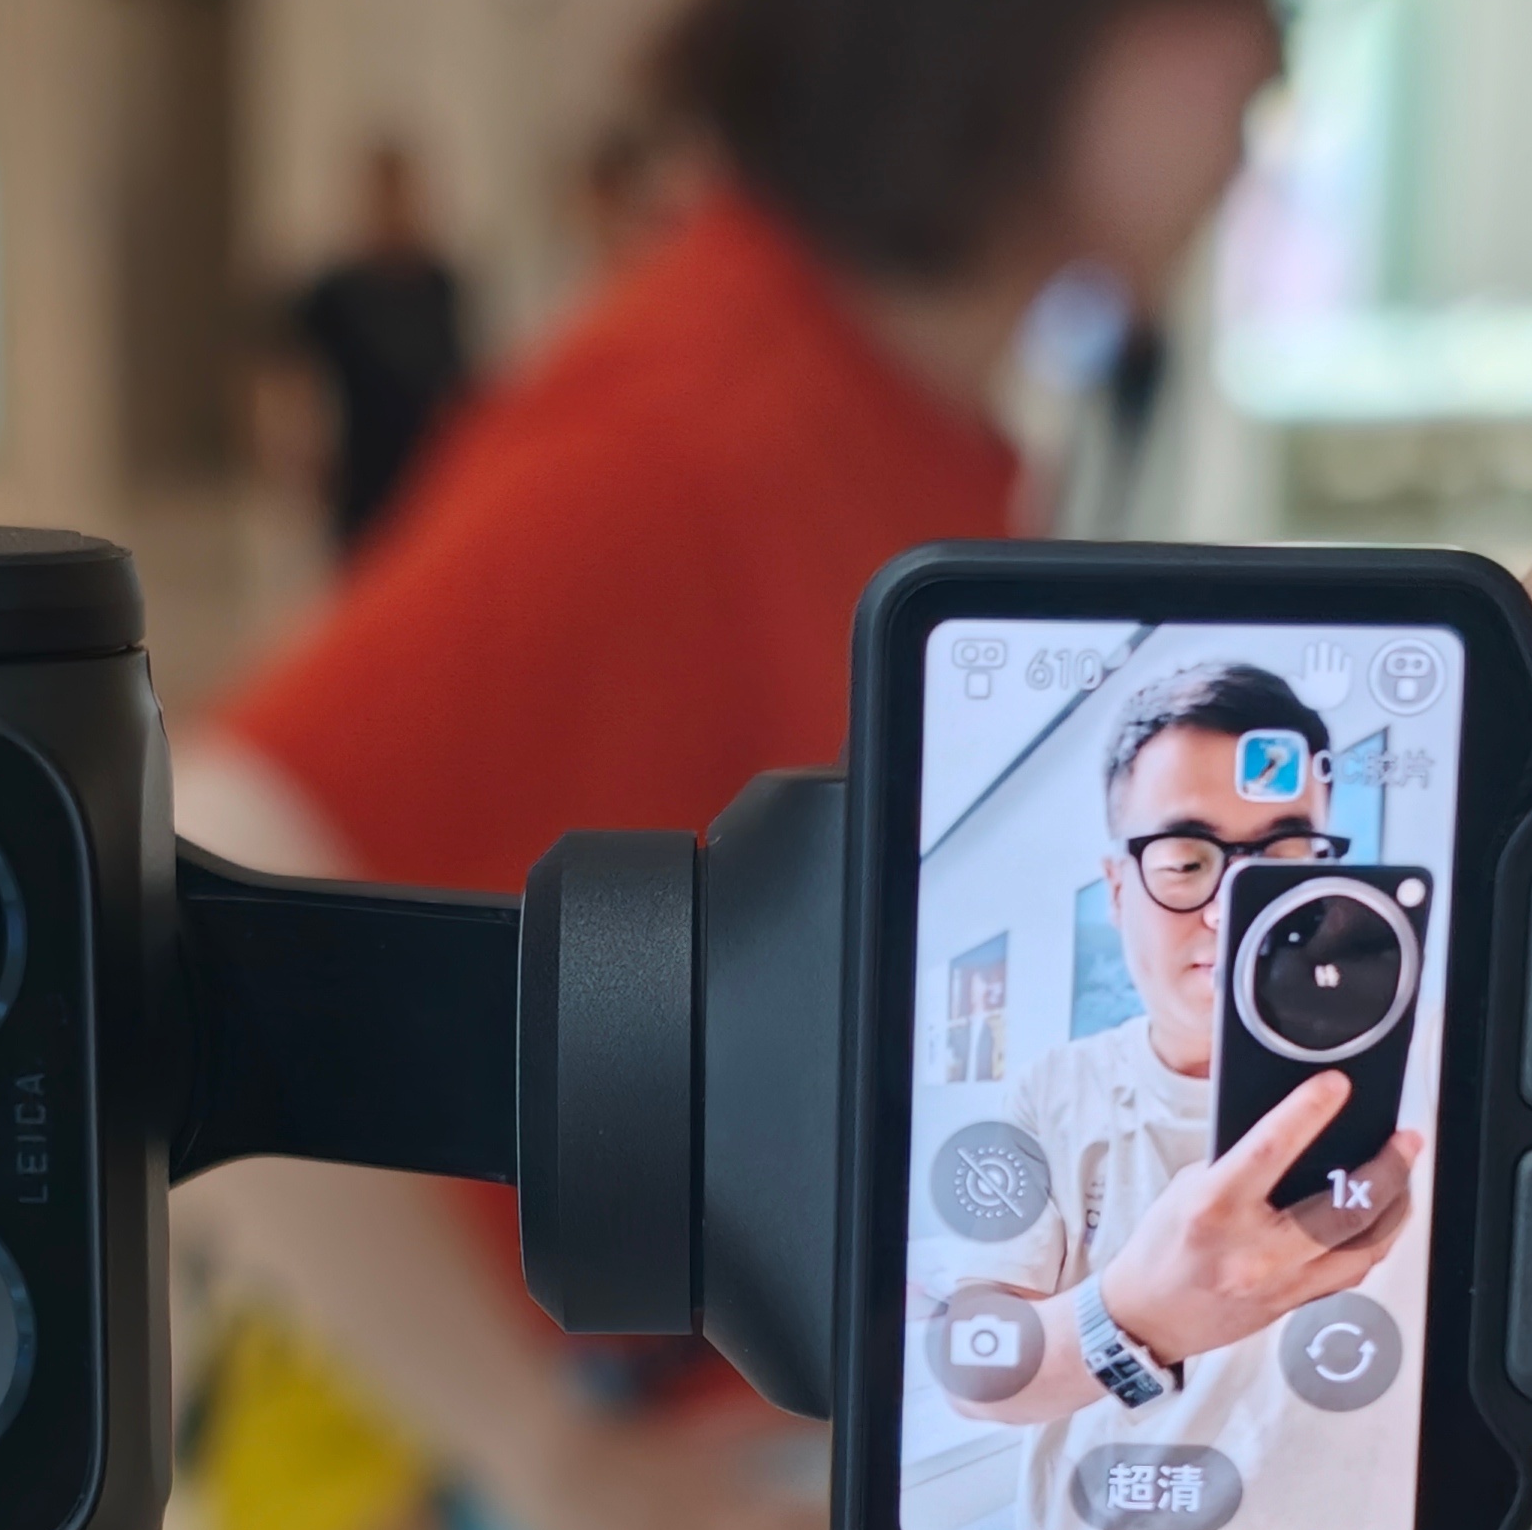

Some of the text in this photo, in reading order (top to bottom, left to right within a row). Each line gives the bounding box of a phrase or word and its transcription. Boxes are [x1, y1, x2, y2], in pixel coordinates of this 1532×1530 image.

[15, 1073, 49, 1204] LEICA
[1326, 1168, 1373, 1210] 1x
[1107, 1462, 1204, 1513] 超清
